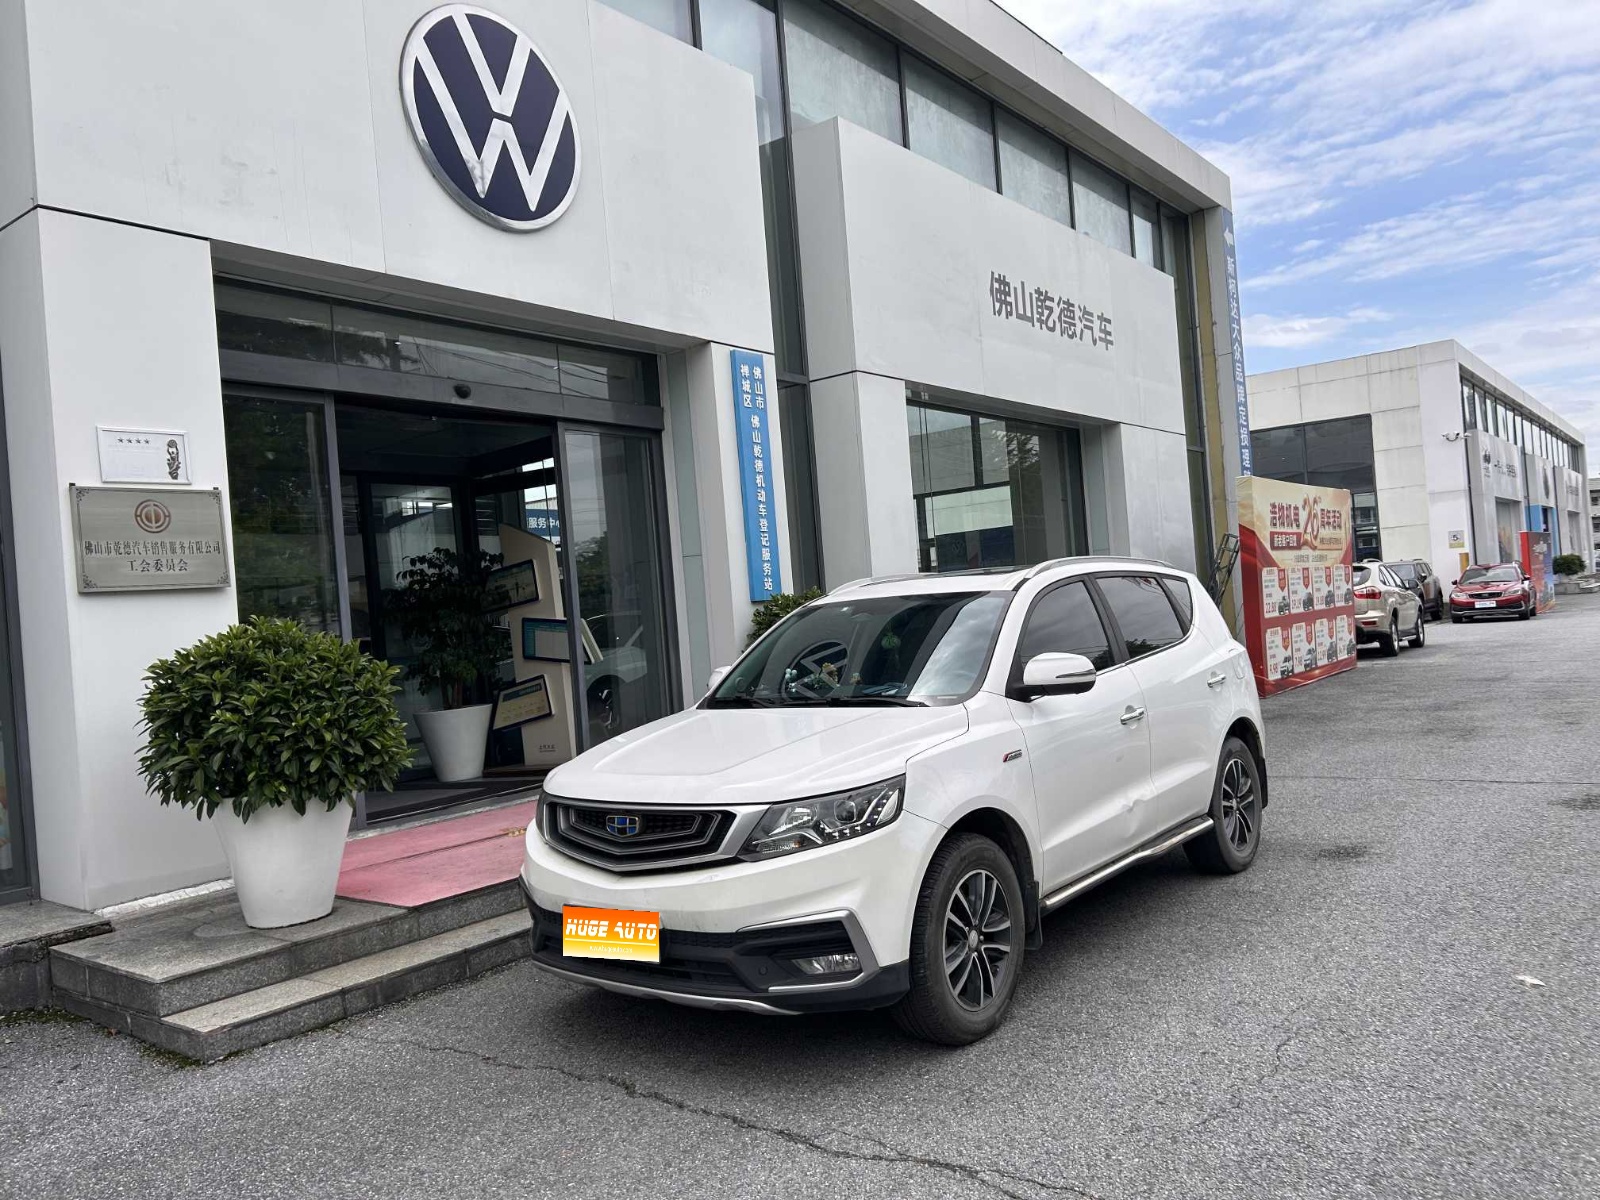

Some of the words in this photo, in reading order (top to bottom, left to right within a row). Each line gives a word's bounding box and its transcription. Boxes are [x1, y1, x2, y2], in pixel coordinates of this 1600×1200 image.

[989, 270, 1114, 351] 佛山乾德汽车
[740, 364, 752, 408] 禅城区
[753, 365, 765, 409] 佛山市
[527, 516, 560, 529] 服务中
[751, 415, 773, 591] 佛山乾德机动车登记服务站
[84, 540, 221, 556] 佛山市乾德汽车销售服务有限公司
[127, 558, 188, 573] 工会委员会
